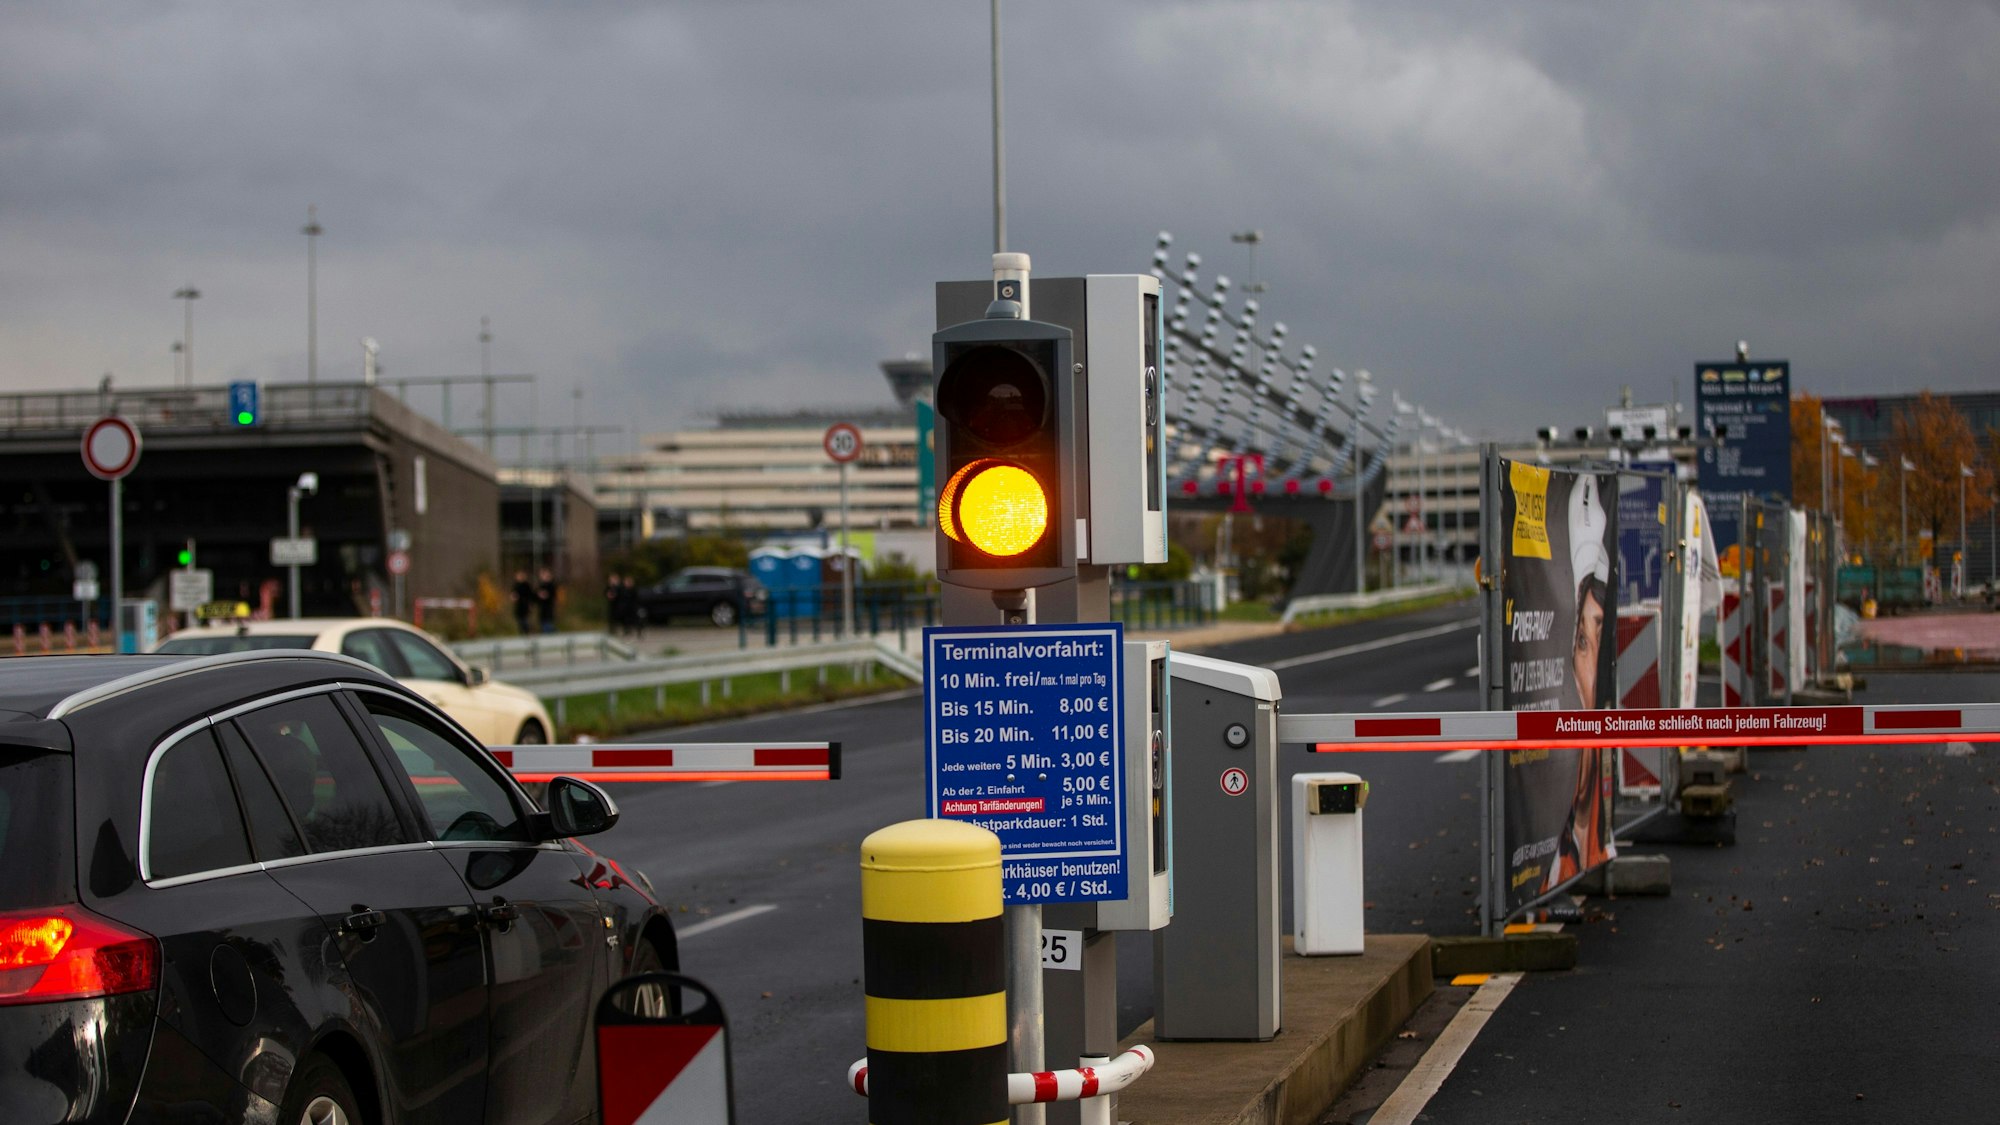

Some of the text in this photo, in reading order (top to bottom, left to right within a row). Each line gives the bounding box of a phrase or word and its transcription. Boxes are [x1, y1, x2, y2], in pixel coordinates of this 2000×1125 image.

[942, 641, 1103, 660] Terminalvorfahrt:
[941, 674, 959, 688] 10
[965, 673, 999, 688] Min.
[1060, 674, 1063, 684] 1
[1066, 674, 1078, 684] mal
[1080, 676, 1091, 687] pro
[1093, 673, 1105, 687] Tag
[942, 697, 1108, 716] Bis 15 Min. 8,00 €
[942, 724, 1108, 743] Bis 20 Min. 11,00 €
[1556, 714, 1827, 734] Achtung Schranke schließt nach jedem Fahrzeug!
[942, 751, 1109, 771] Jede weitere 5 Min. 3,00 €
[943, 786, 1024, 796] Ab der 2. Einfahrt
[1063, 776, 1109, 794] 5,00 €
[945, 800, 1042, 813] Achtung Tarifänderungen!
[1061, 794, 1111, 808] je 5 Min.
[972, 814, 1107, 832] hstparkdauer: 1 Std.
[1003, 860, 1120, 879] rkhäuser benutzen!
[1017, 883, 1050, 900] 4,00
[1056, 882, 1065, 896] €
[1070, 881, 1075, 896] /
[1081, 880, 1111, 895] Std.
